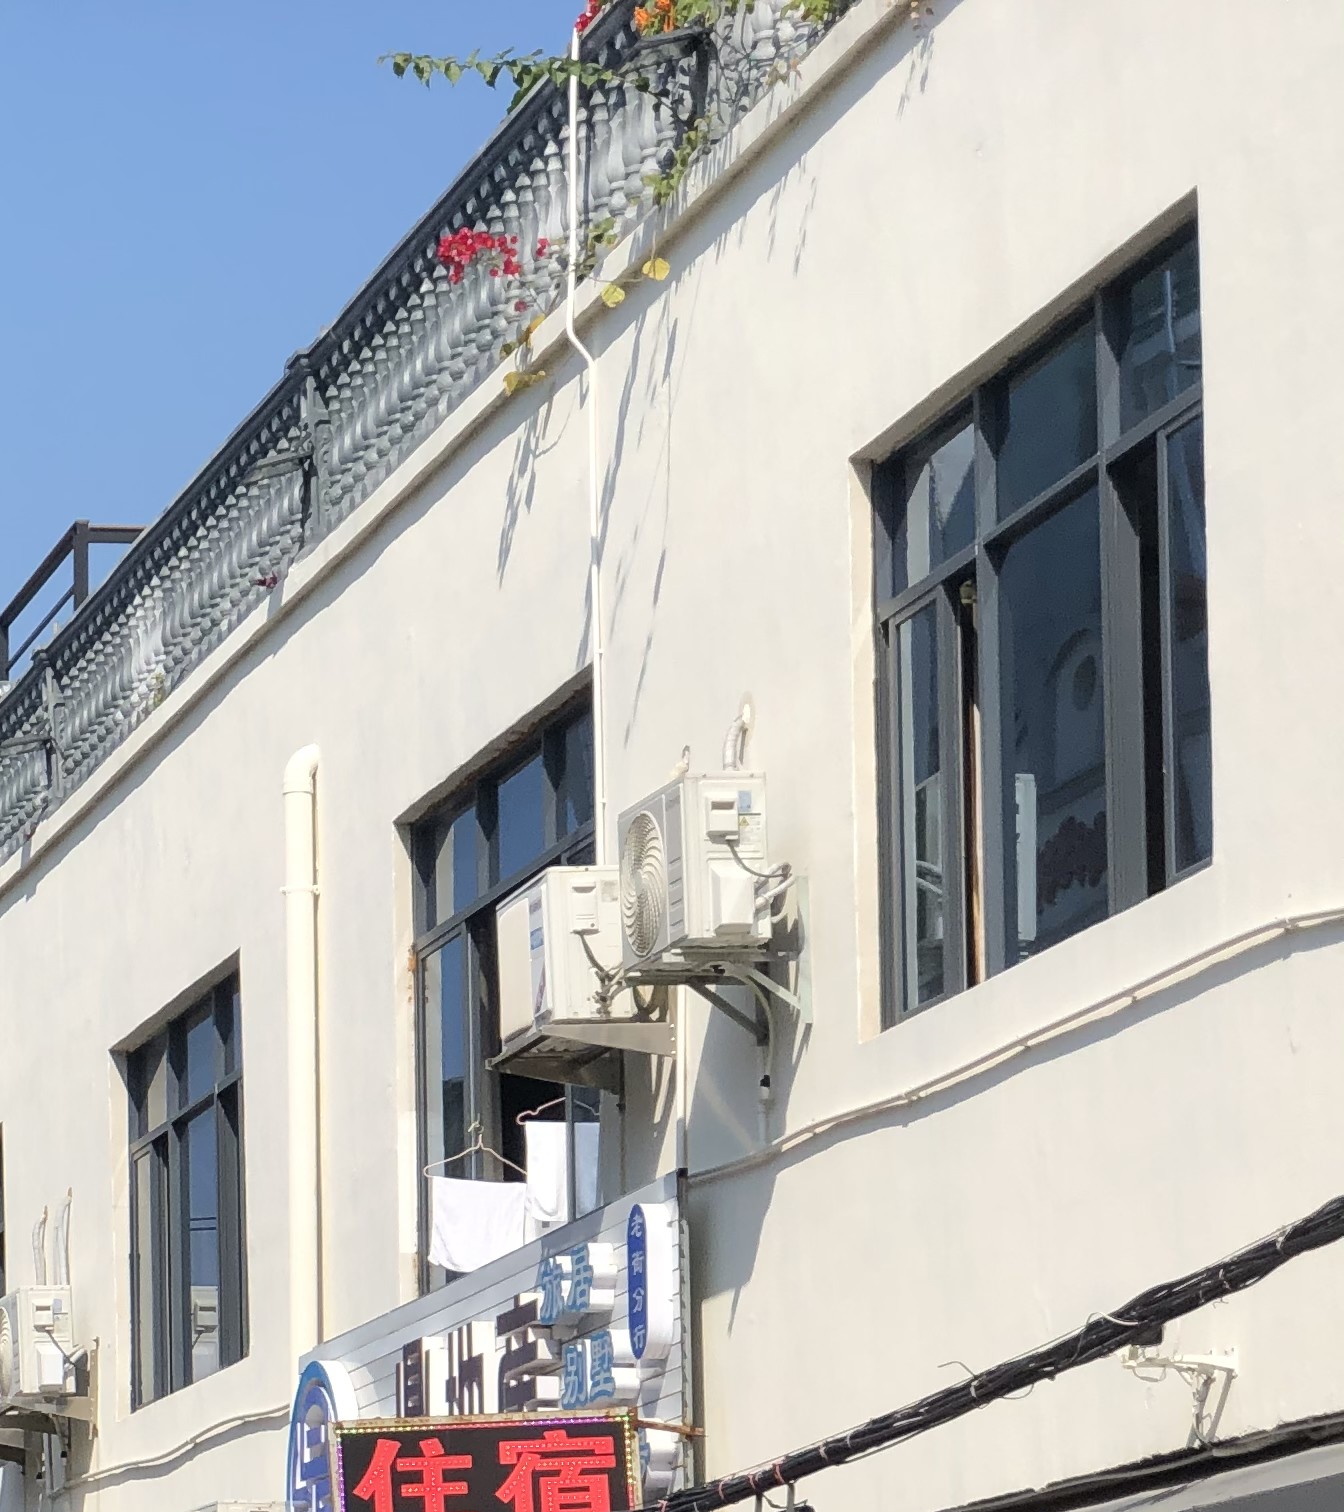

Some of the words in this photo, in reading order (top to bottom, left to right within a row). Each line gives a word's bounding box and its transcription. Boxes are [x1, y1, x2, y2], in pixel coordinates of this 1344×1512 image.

[539, 1242, 593, 1325] 旅居
[630, 1213, 645, 1354] 老街分行
[561, 1330, 615, 1410] 别墅
